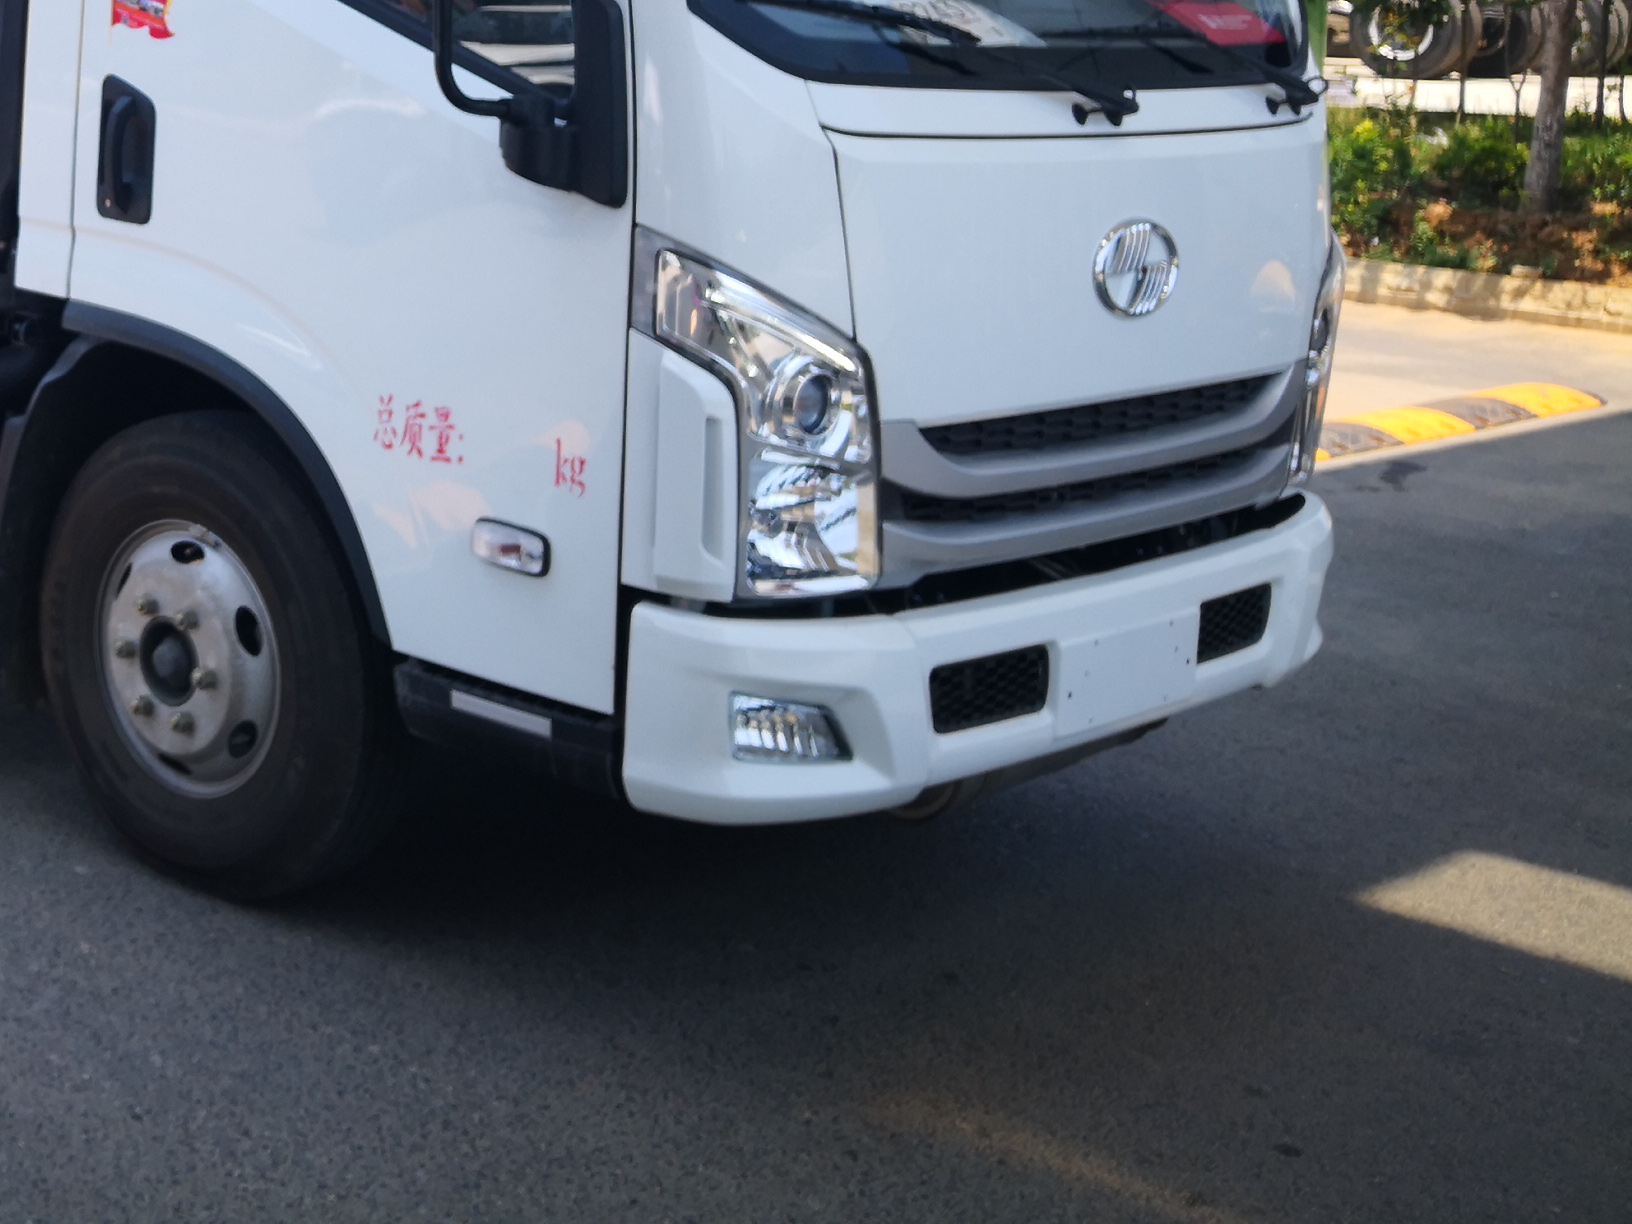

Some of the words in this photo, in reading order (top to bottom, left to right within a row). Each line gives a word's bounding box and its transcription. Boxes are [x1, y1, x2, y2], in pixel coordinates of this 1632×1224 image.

[373, 393, 464, 464] 总质量:
[555, 437, 587, 498] kg
